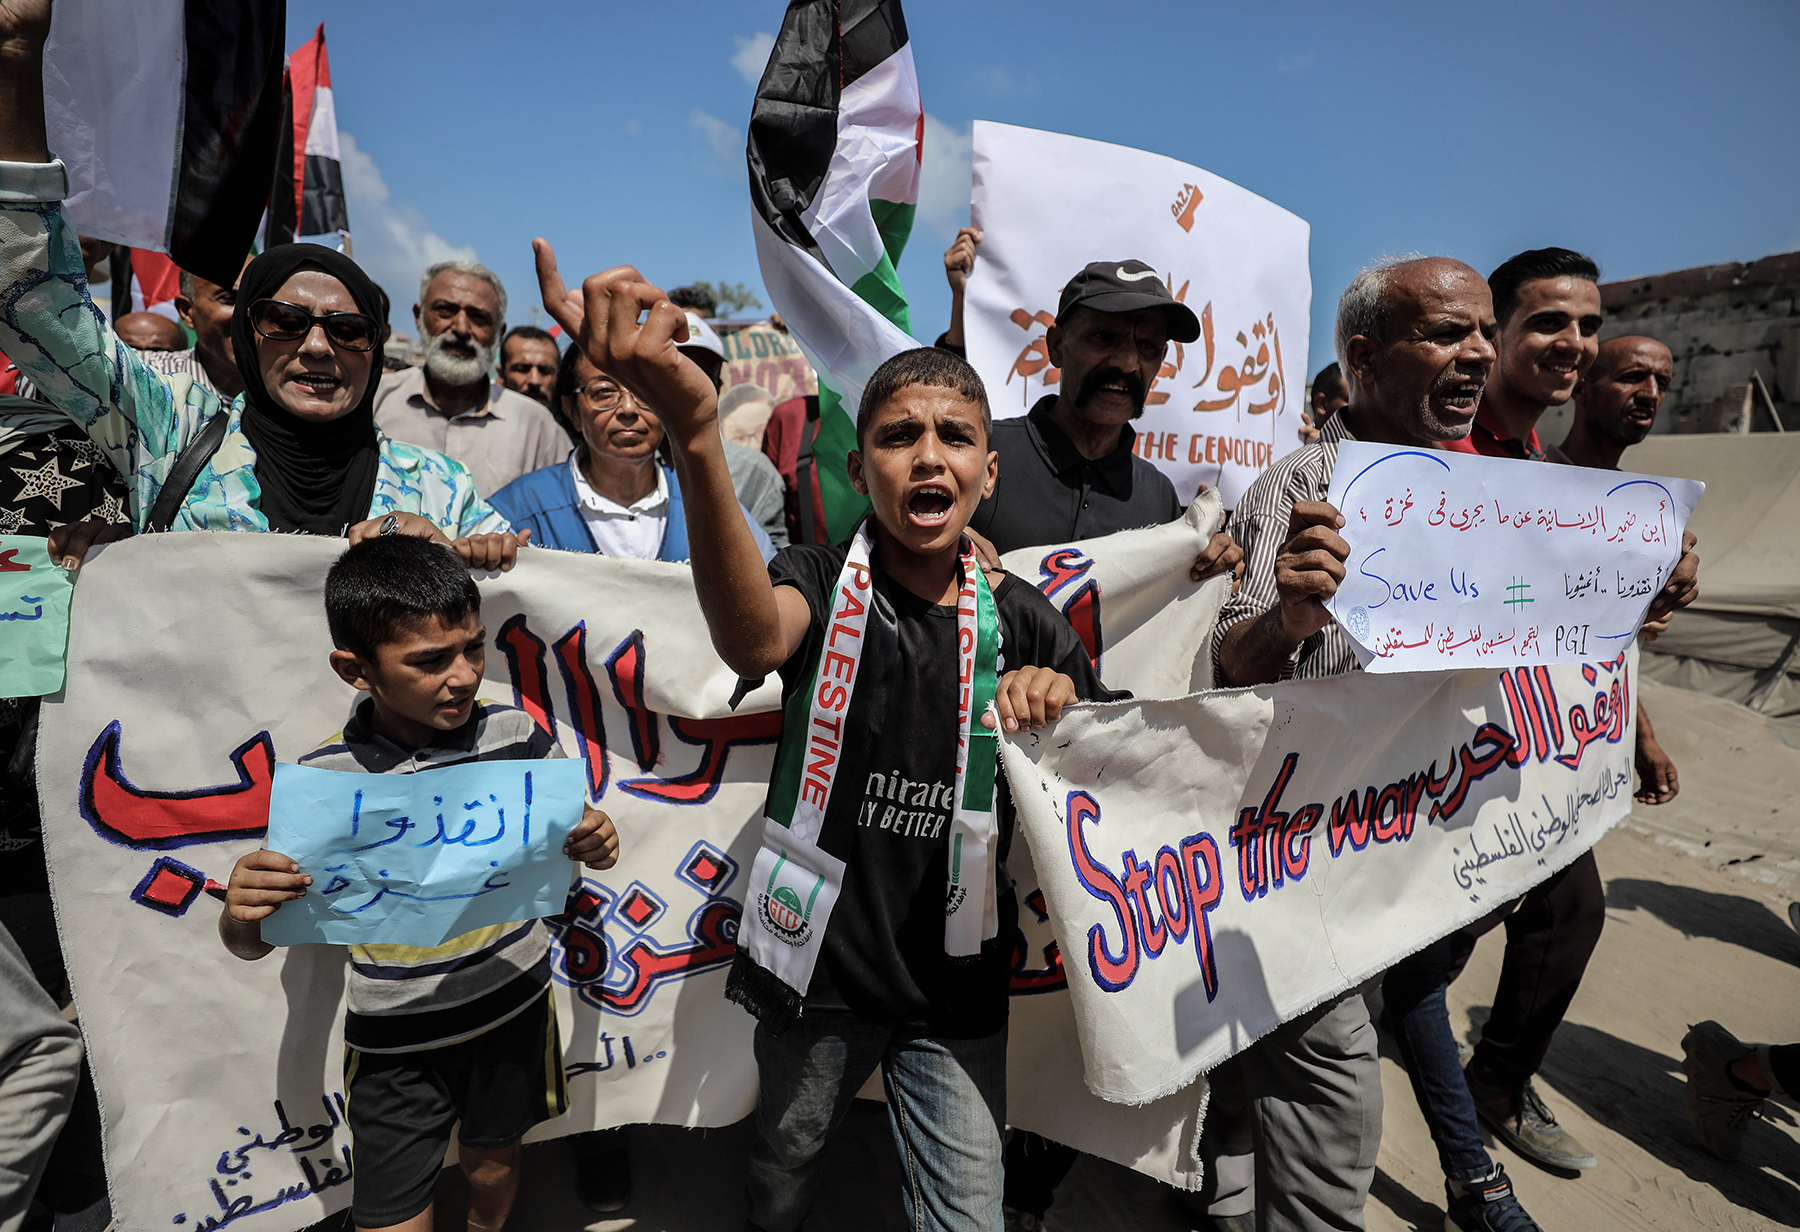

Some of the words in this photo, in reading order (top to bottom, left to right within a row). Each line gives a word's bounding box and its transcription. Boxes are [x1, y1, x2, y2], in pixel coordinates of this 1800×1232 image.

[719, 331, 800, 361] ILDRE
[1494, 499, 1510, 524] ما
[1513, 510, 1533, 529] عن
[1360, 547, 1438, 609] Save
[1450, 566, 1479, 598] Us
[1555, 624, 1590, 657] PGI
[802, 561, 872, 812] PALESTINE
[880, 805, 946, 838] BETTER
[321, 860, 511, 915] غزة
[1066, 790, 1225, 1004] Stop
[1229, 752, 1325, 903] the
[1327, 770, 1427, 859] war
